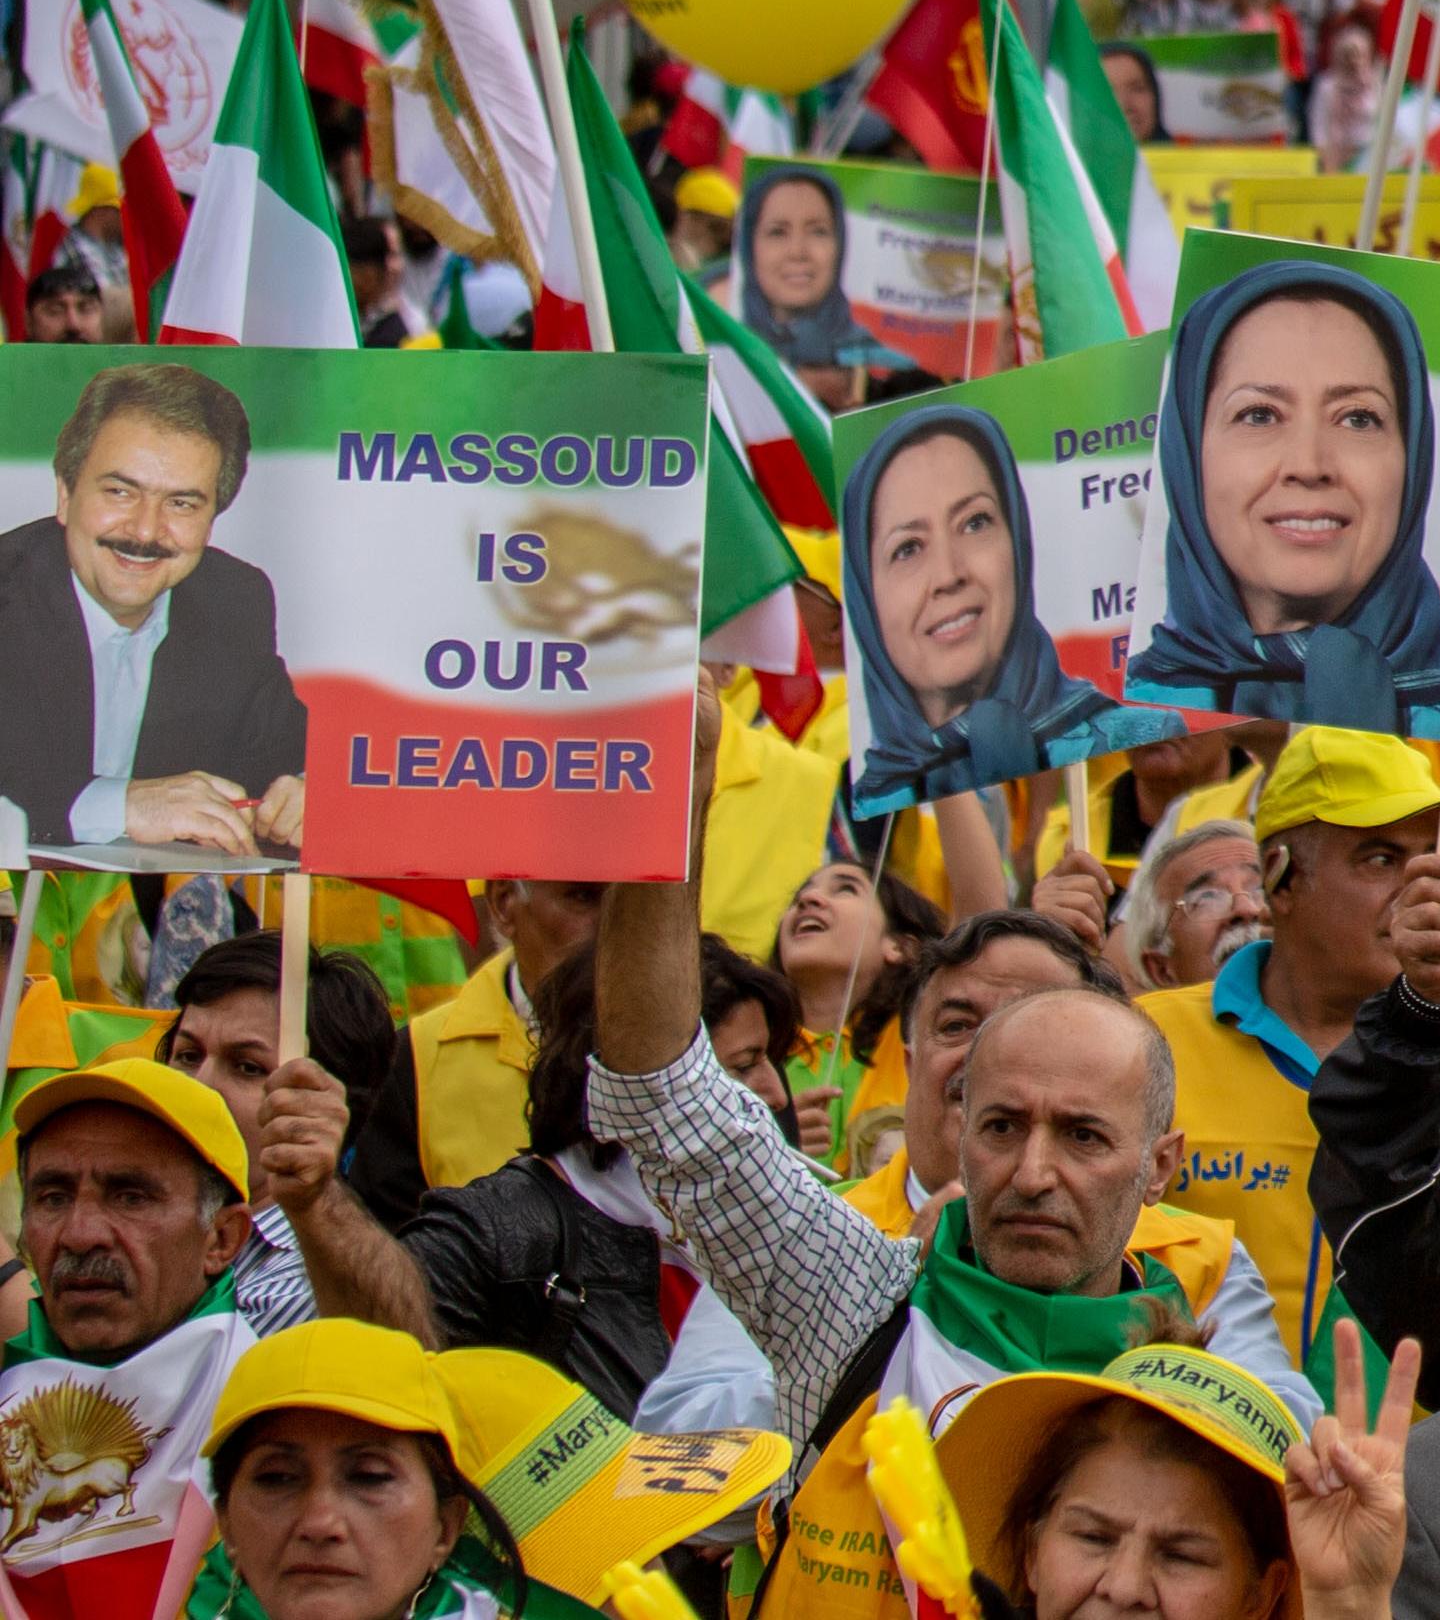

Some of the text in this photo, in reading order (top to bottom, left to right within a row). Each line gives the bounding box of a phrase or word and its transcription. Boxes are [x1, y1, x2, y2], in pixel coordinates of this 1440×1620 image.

[337, 431, 698, 488] MASSOUD
[476, 532, 548, 585] IS
[424, 639, 590, 692] OUR
[348, 736, 654, 793] LEADER
[790, 1511, 836, 1547] Free
[796, 1546, 870, 1589] aryam
